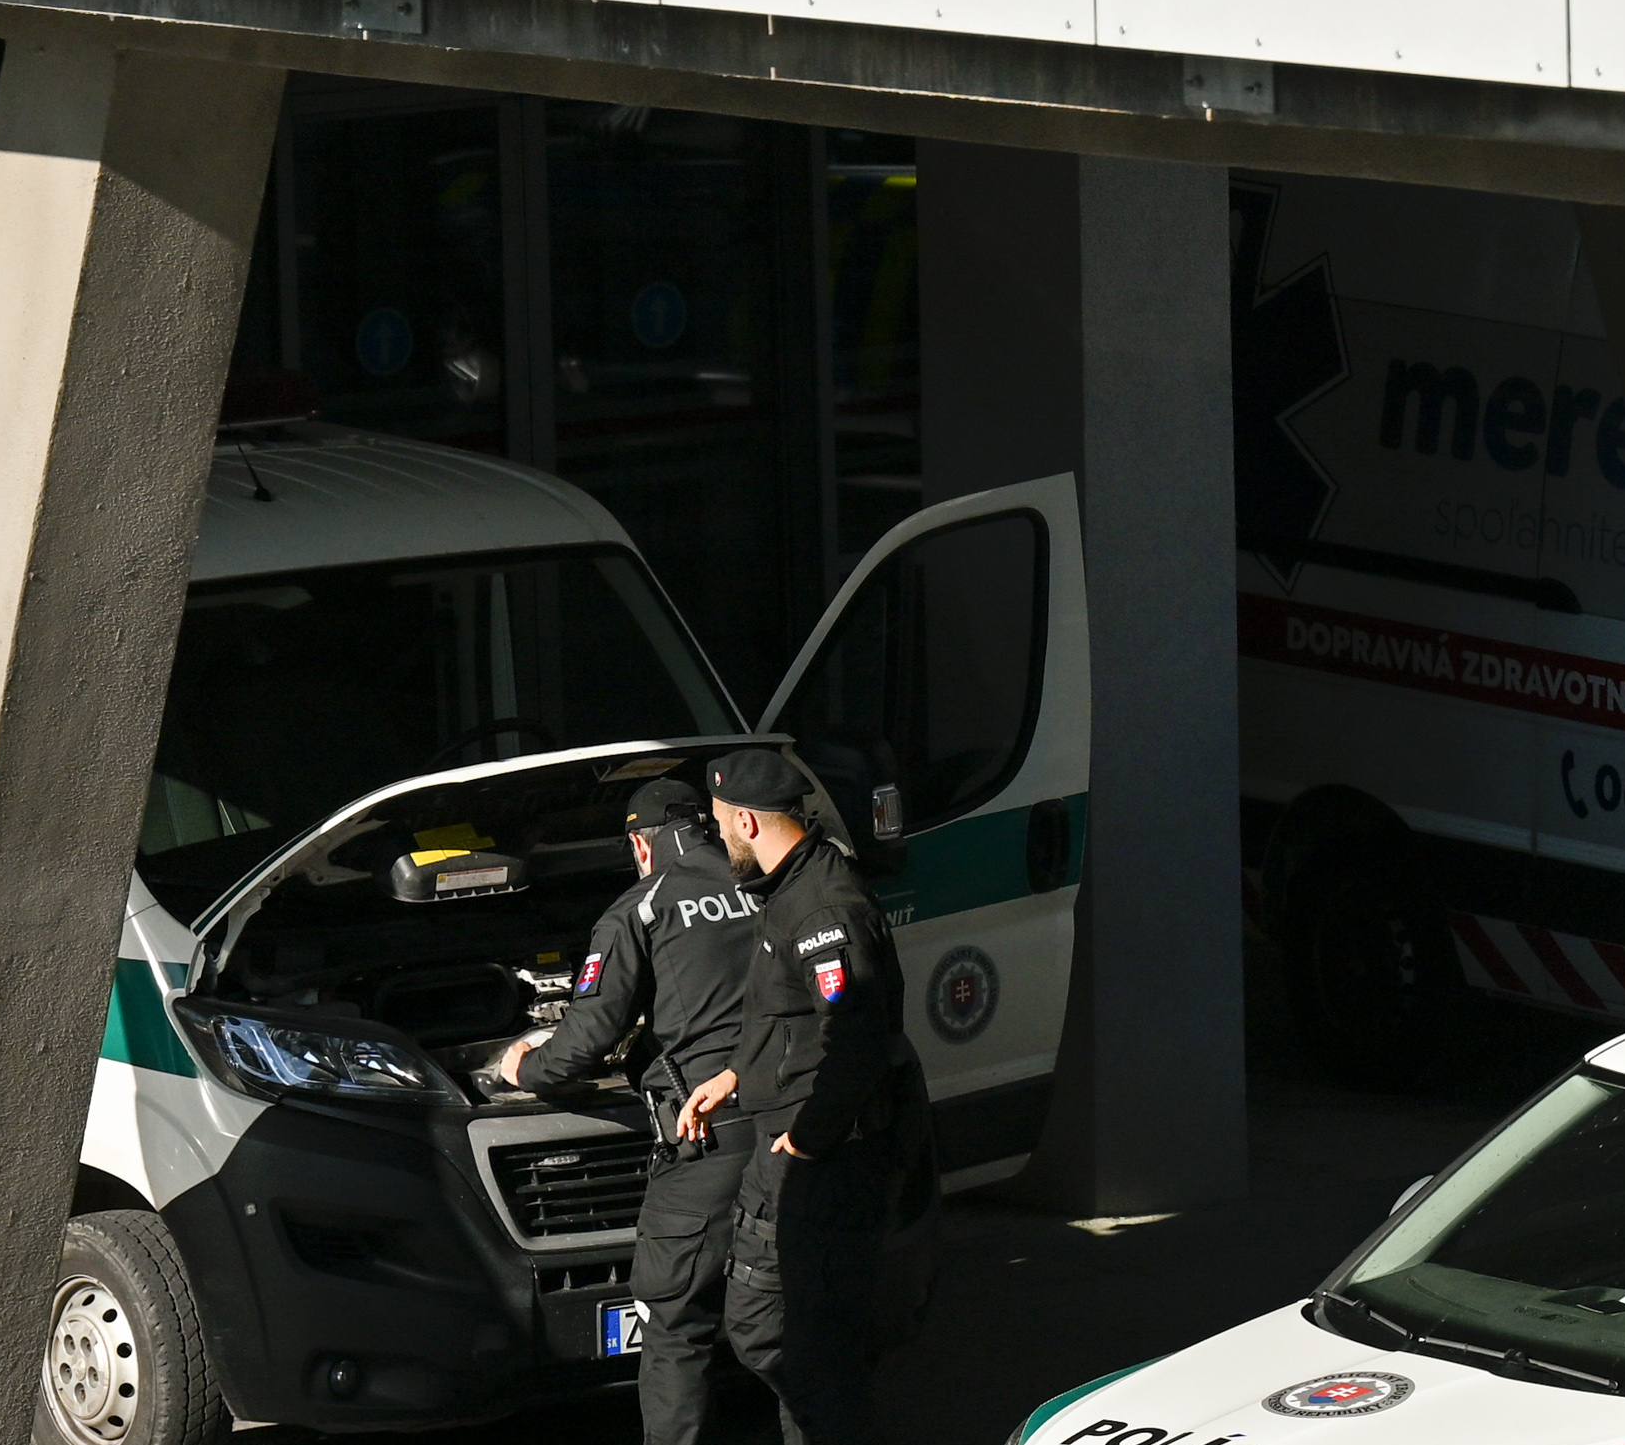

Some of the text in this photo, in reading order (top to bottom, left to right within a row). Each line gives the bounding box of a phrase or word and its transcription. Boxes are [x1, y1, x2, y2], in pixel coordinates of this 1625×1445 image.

[1285, 617, 1455, 681] DOPRAVNÁ
[797, 927, 844, 955] POLÍCIA
[607, 1337, 618, 1348] SK
[1296, 1403, 1382, 1417] REPUBLIKY
